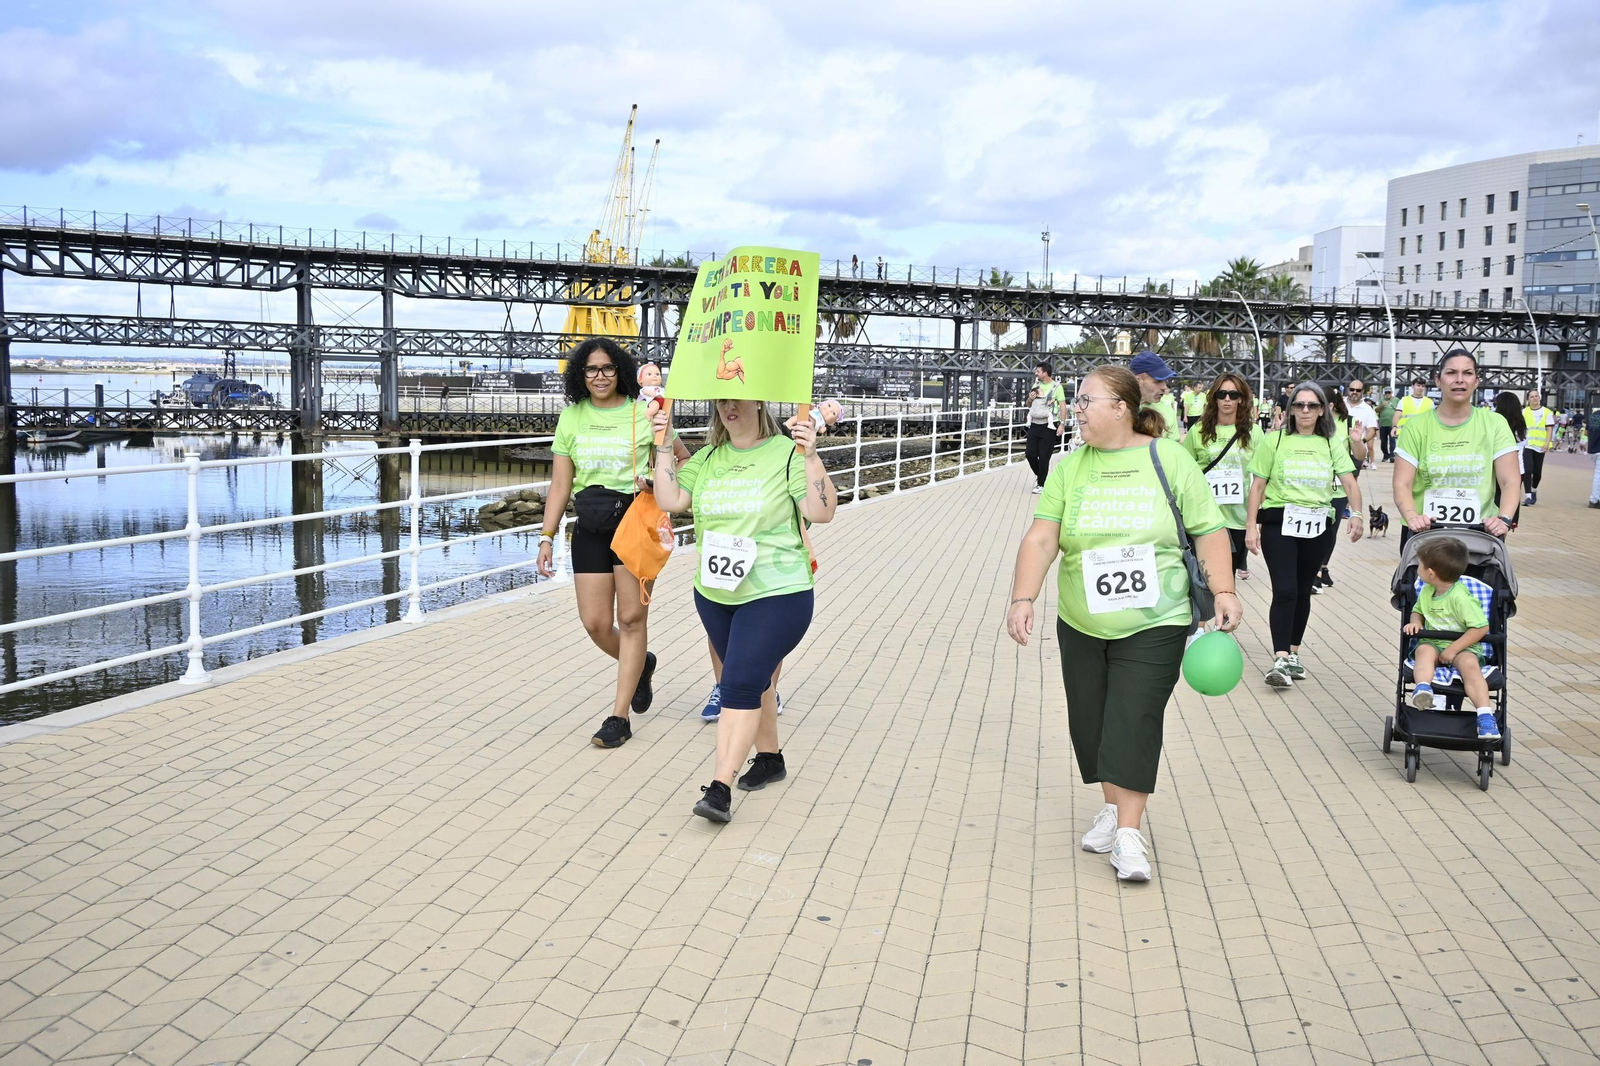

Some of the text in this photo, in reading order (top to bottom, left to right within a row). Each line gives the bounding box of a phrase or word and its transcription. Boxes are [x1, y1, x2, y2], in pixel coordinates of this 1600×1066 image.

[724, 254, 803, 278] CARRERA
[701, 296, 717, 313] VA
[575, 434, 588, 444] En
[575, 446, 629, 457] contra el
[1428, 453, 1443, 463] En
[577, 456, 627, 471] cáncer
[1428, 463, 1471, 475] contra
[1283, 469, 1319, 478] contra
[1084, 483, 1158, 497] En marcha
[1208, 482, 1240, 496] 112
[700, 499, 765, 516] cáncer
[1066, 485, 1085, 537] HUELVA
[1080, 498, 1155, 513] contra el
[1079, 511, 1157, 531] cáncer
[708, 555, 745, 578] 626
[1096, 569, 1147, 596] 628
